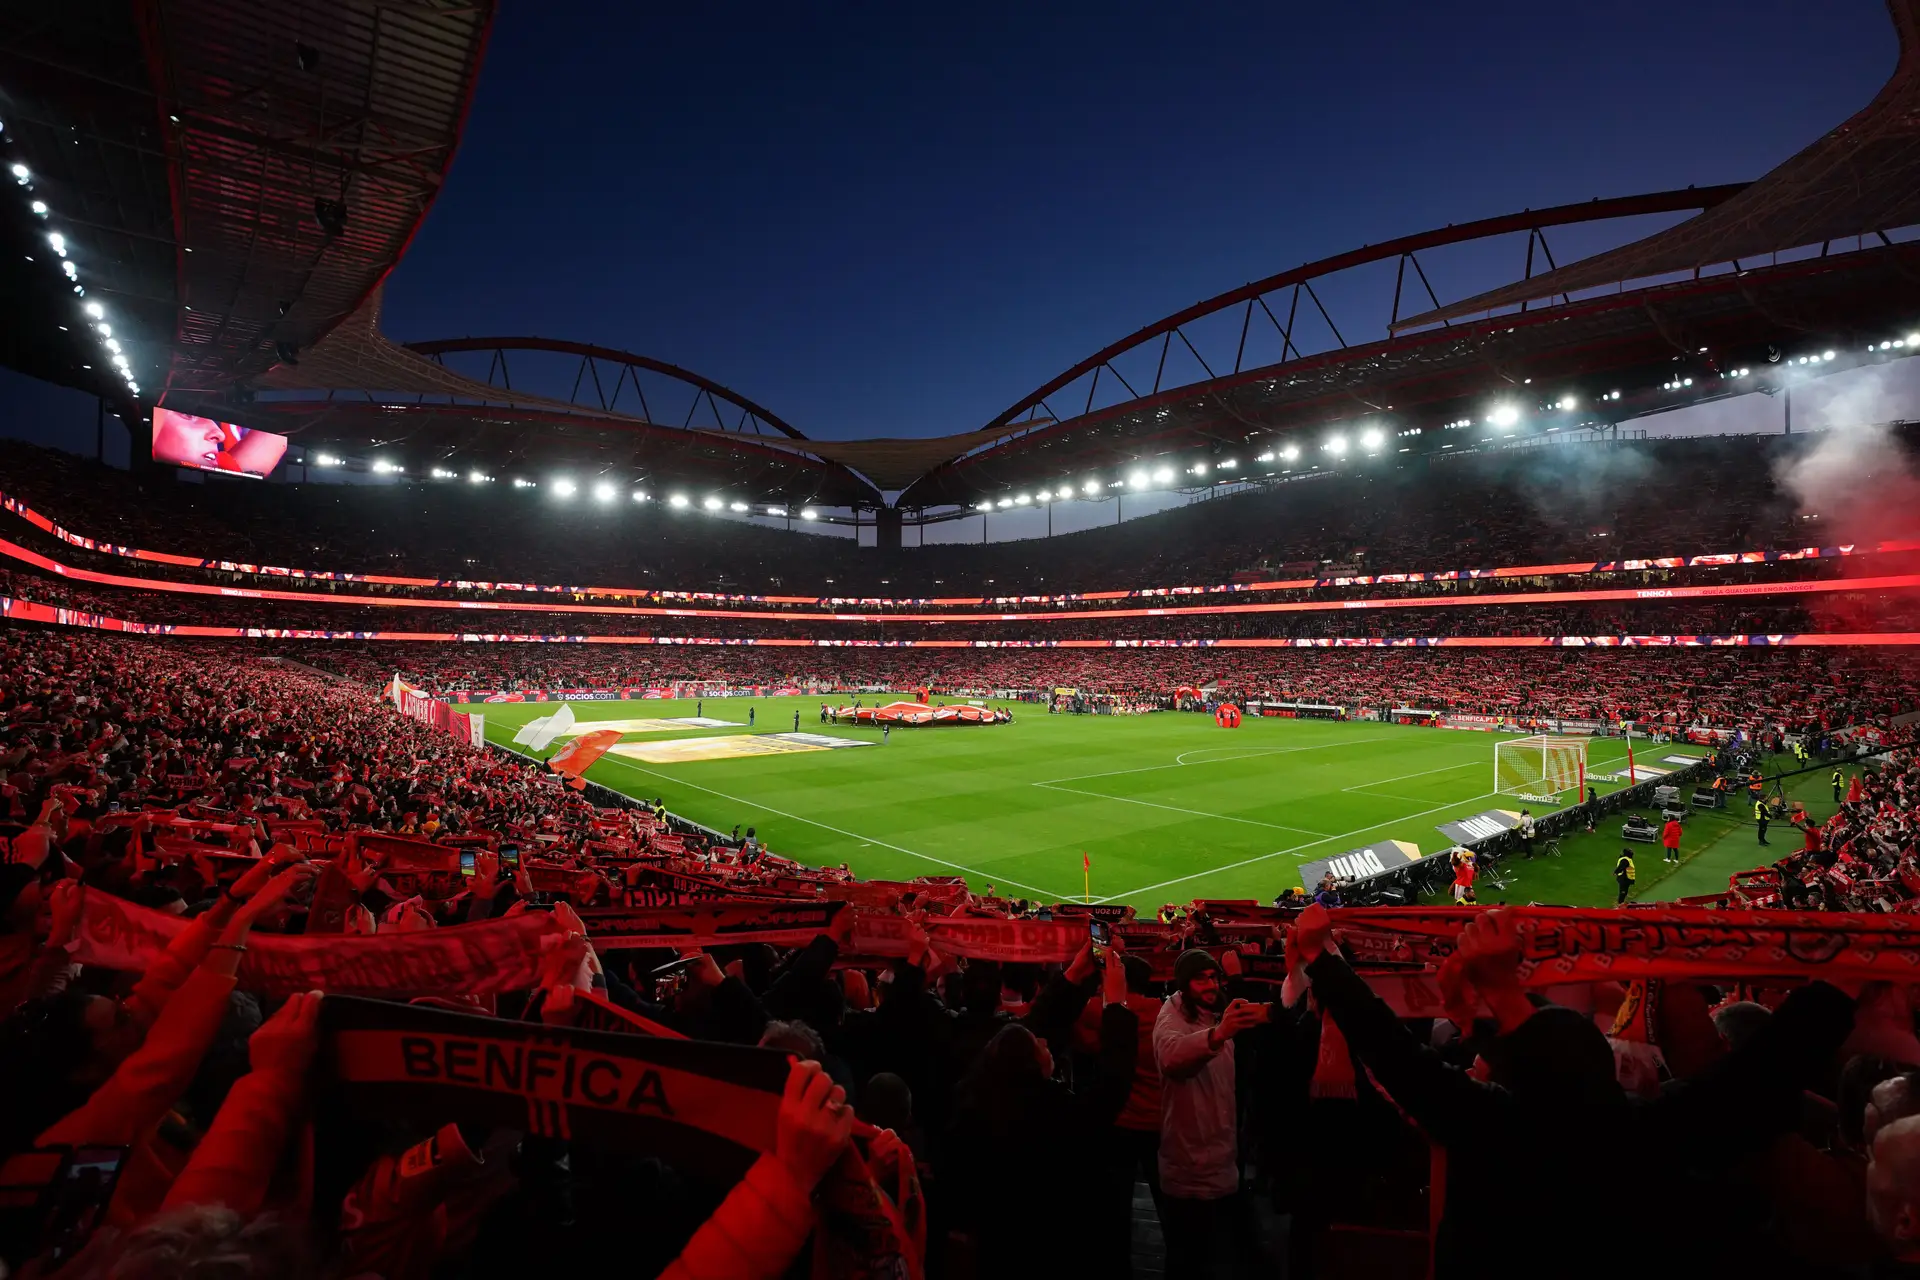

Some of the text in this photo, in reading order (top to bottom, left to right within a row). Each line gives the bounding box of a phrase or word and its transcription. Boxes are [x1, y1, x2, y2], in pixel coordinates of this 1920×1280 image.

[1637, 590, 1665, 598] TENHO
[1763, 585, 1814, 593] ENGRANDECE
[565, 692, 615, 701] socios.com
[1450, 714, 1494, 723] SLBENFICA.PT
[400, 1036, 675, 1117] BENFICA
